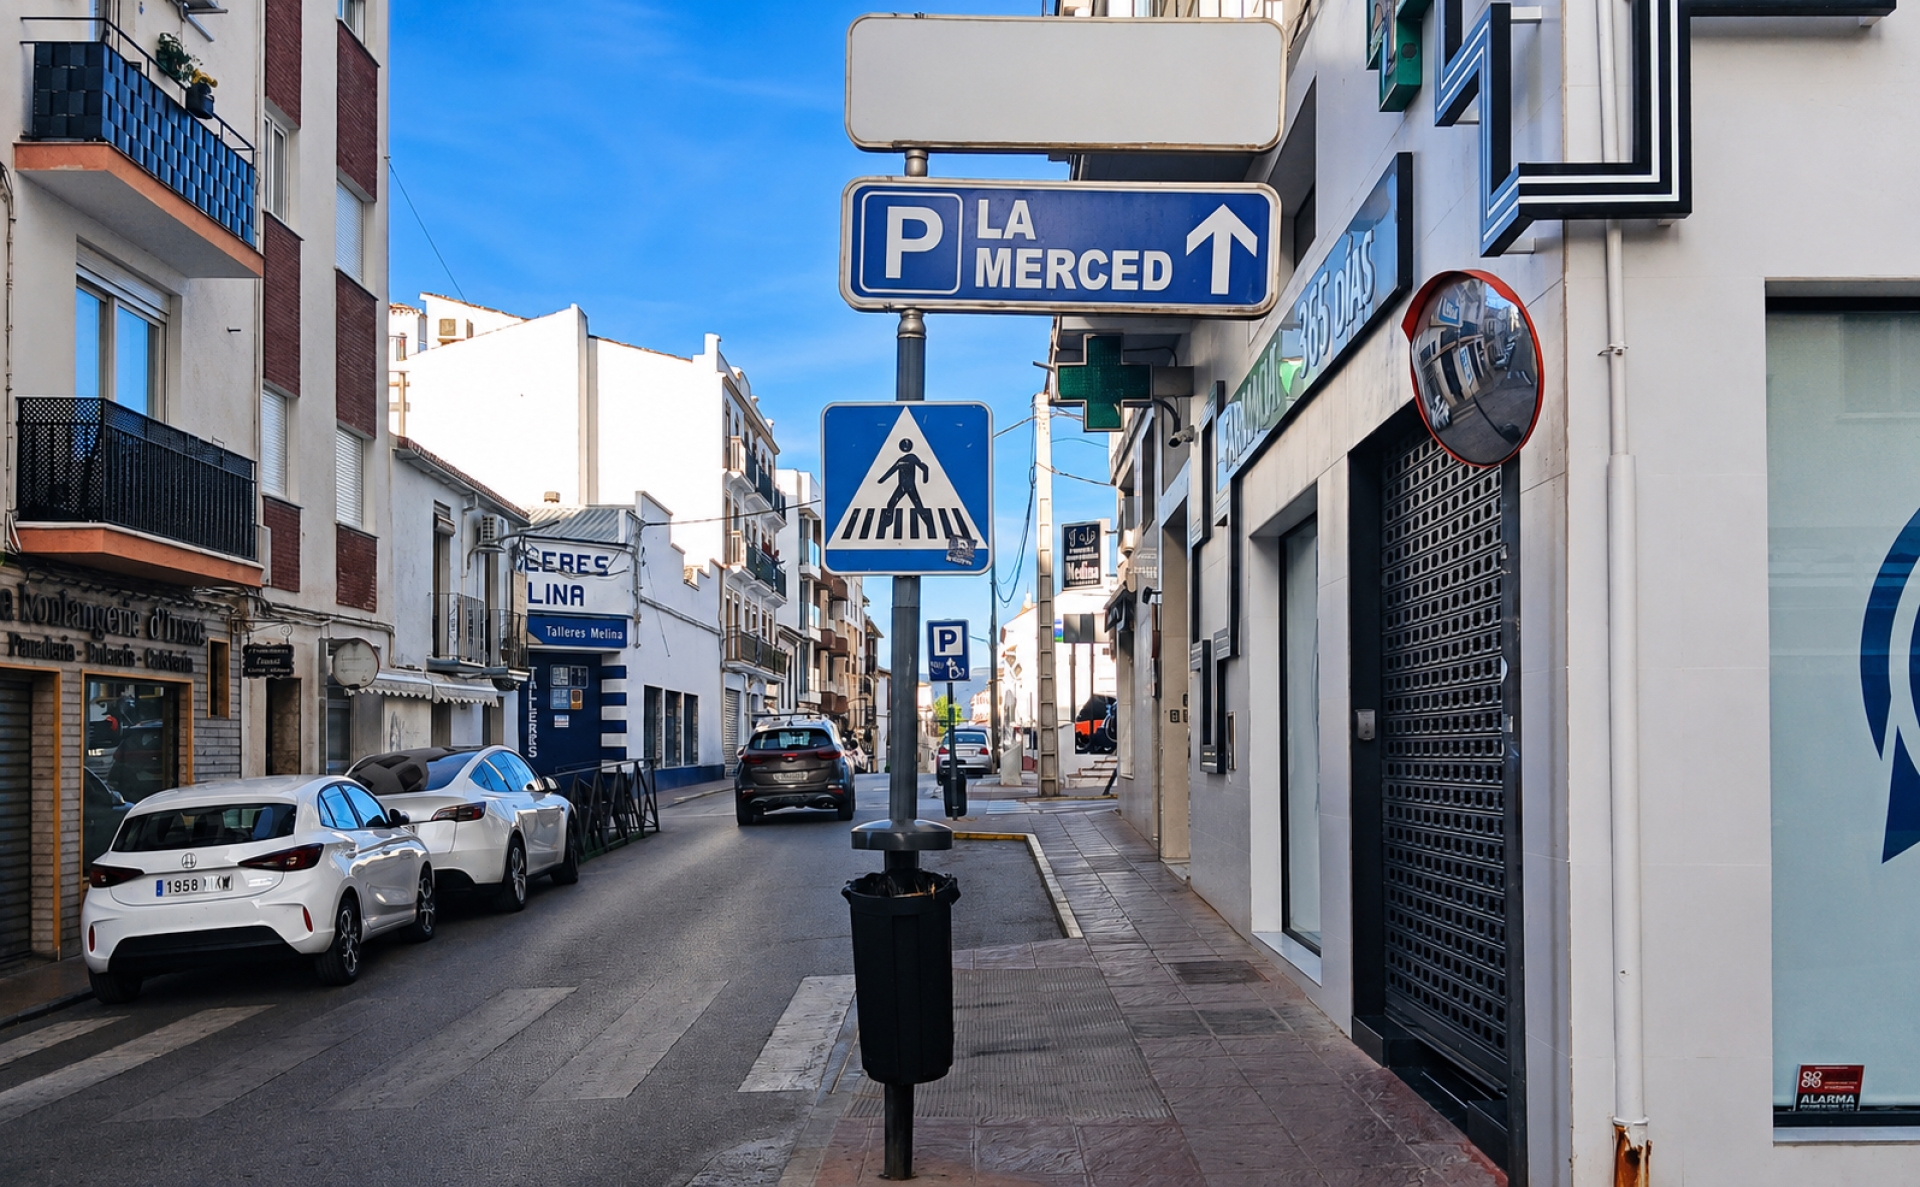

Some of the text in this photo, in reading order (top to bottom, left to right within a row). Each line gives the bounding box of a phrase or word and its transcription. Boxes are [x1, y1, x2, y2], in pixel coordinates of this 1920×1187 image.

[977, 199, 1036, 240] LA
[885, 206, 944, 279] P
[975, 247, 1174, 292] MERCED
[1299, 270, 1330, 379] 365
[1334, 229, 1376, 340] DÍAS
[517, 551, 609, 577] LERES
[528, 582, 584, 606] LINA
[546, 626, 623, 639] Talleres Melina
[939, 629, 957, 653] P
[166, 879, 199, 893] 1958
[1800, 1094, 1855, 1104] ALARMA
